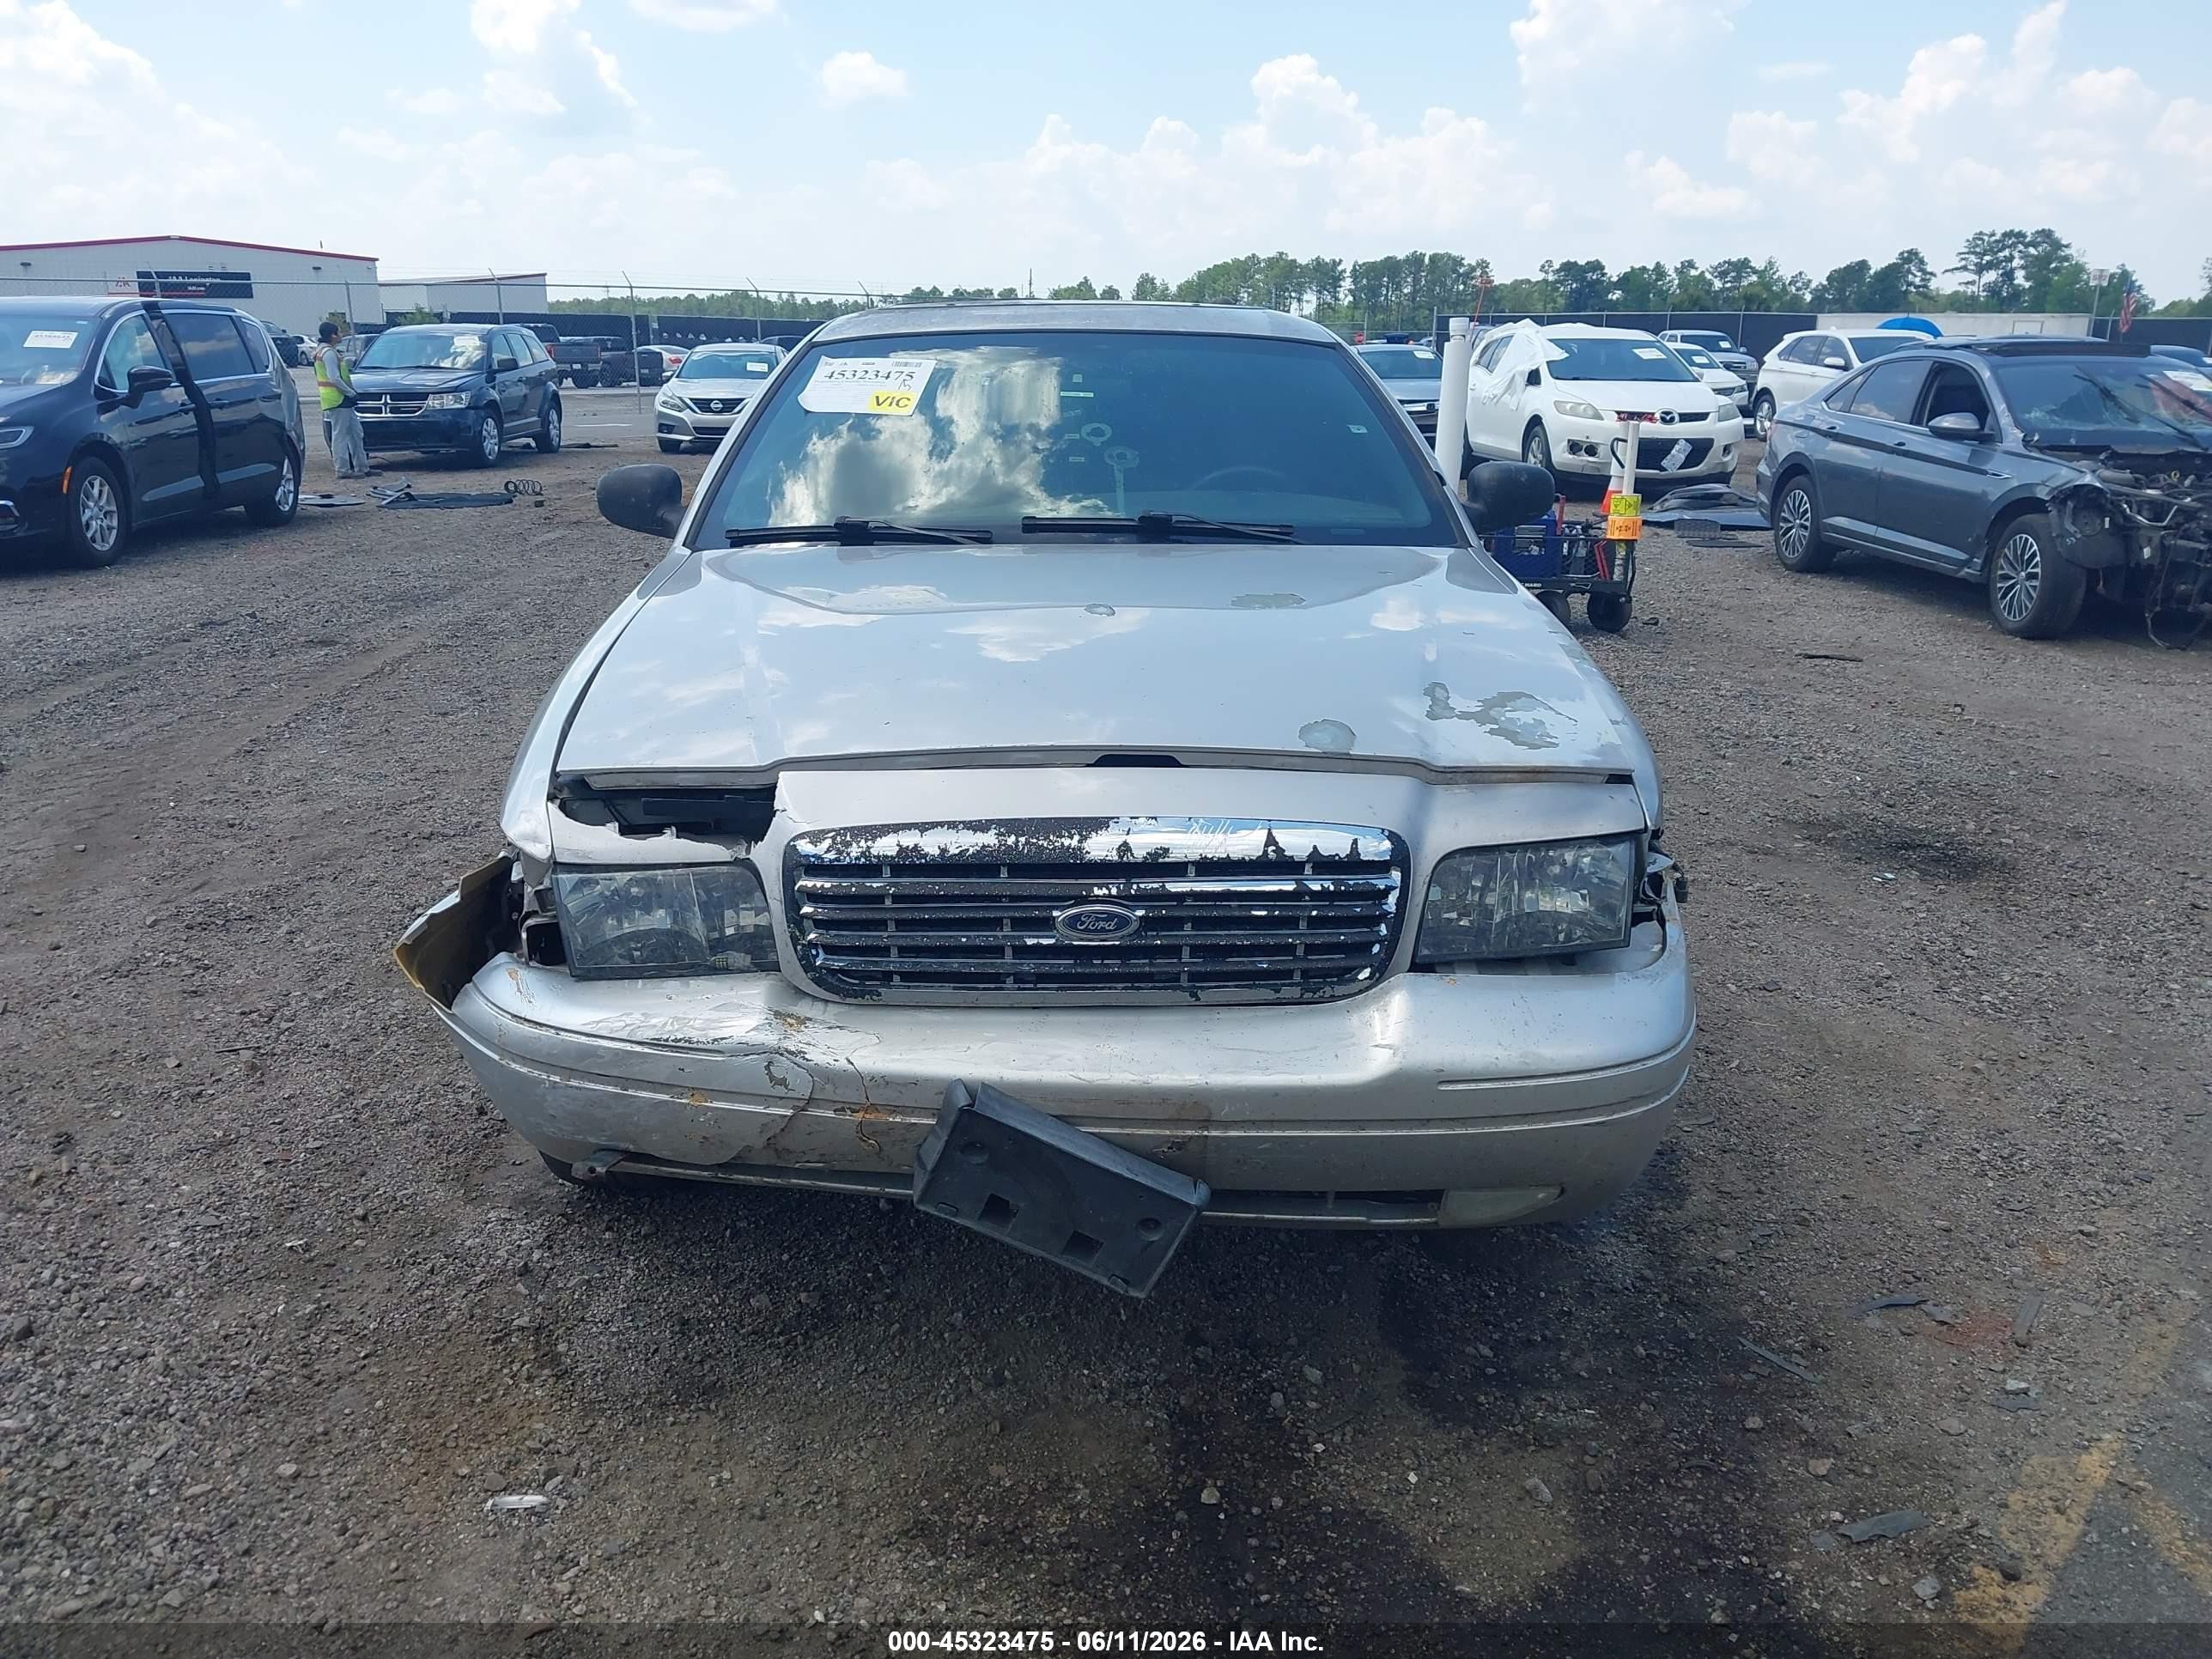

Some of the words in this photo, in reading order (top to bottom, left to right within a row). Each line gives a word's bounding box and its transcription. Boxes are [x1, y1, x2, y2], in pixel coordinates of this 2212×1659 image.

[823, 369, 916, 381] 45323475
[875, 395, 911, 409] VIC
[1077, 913, 1118, 930] Ford
